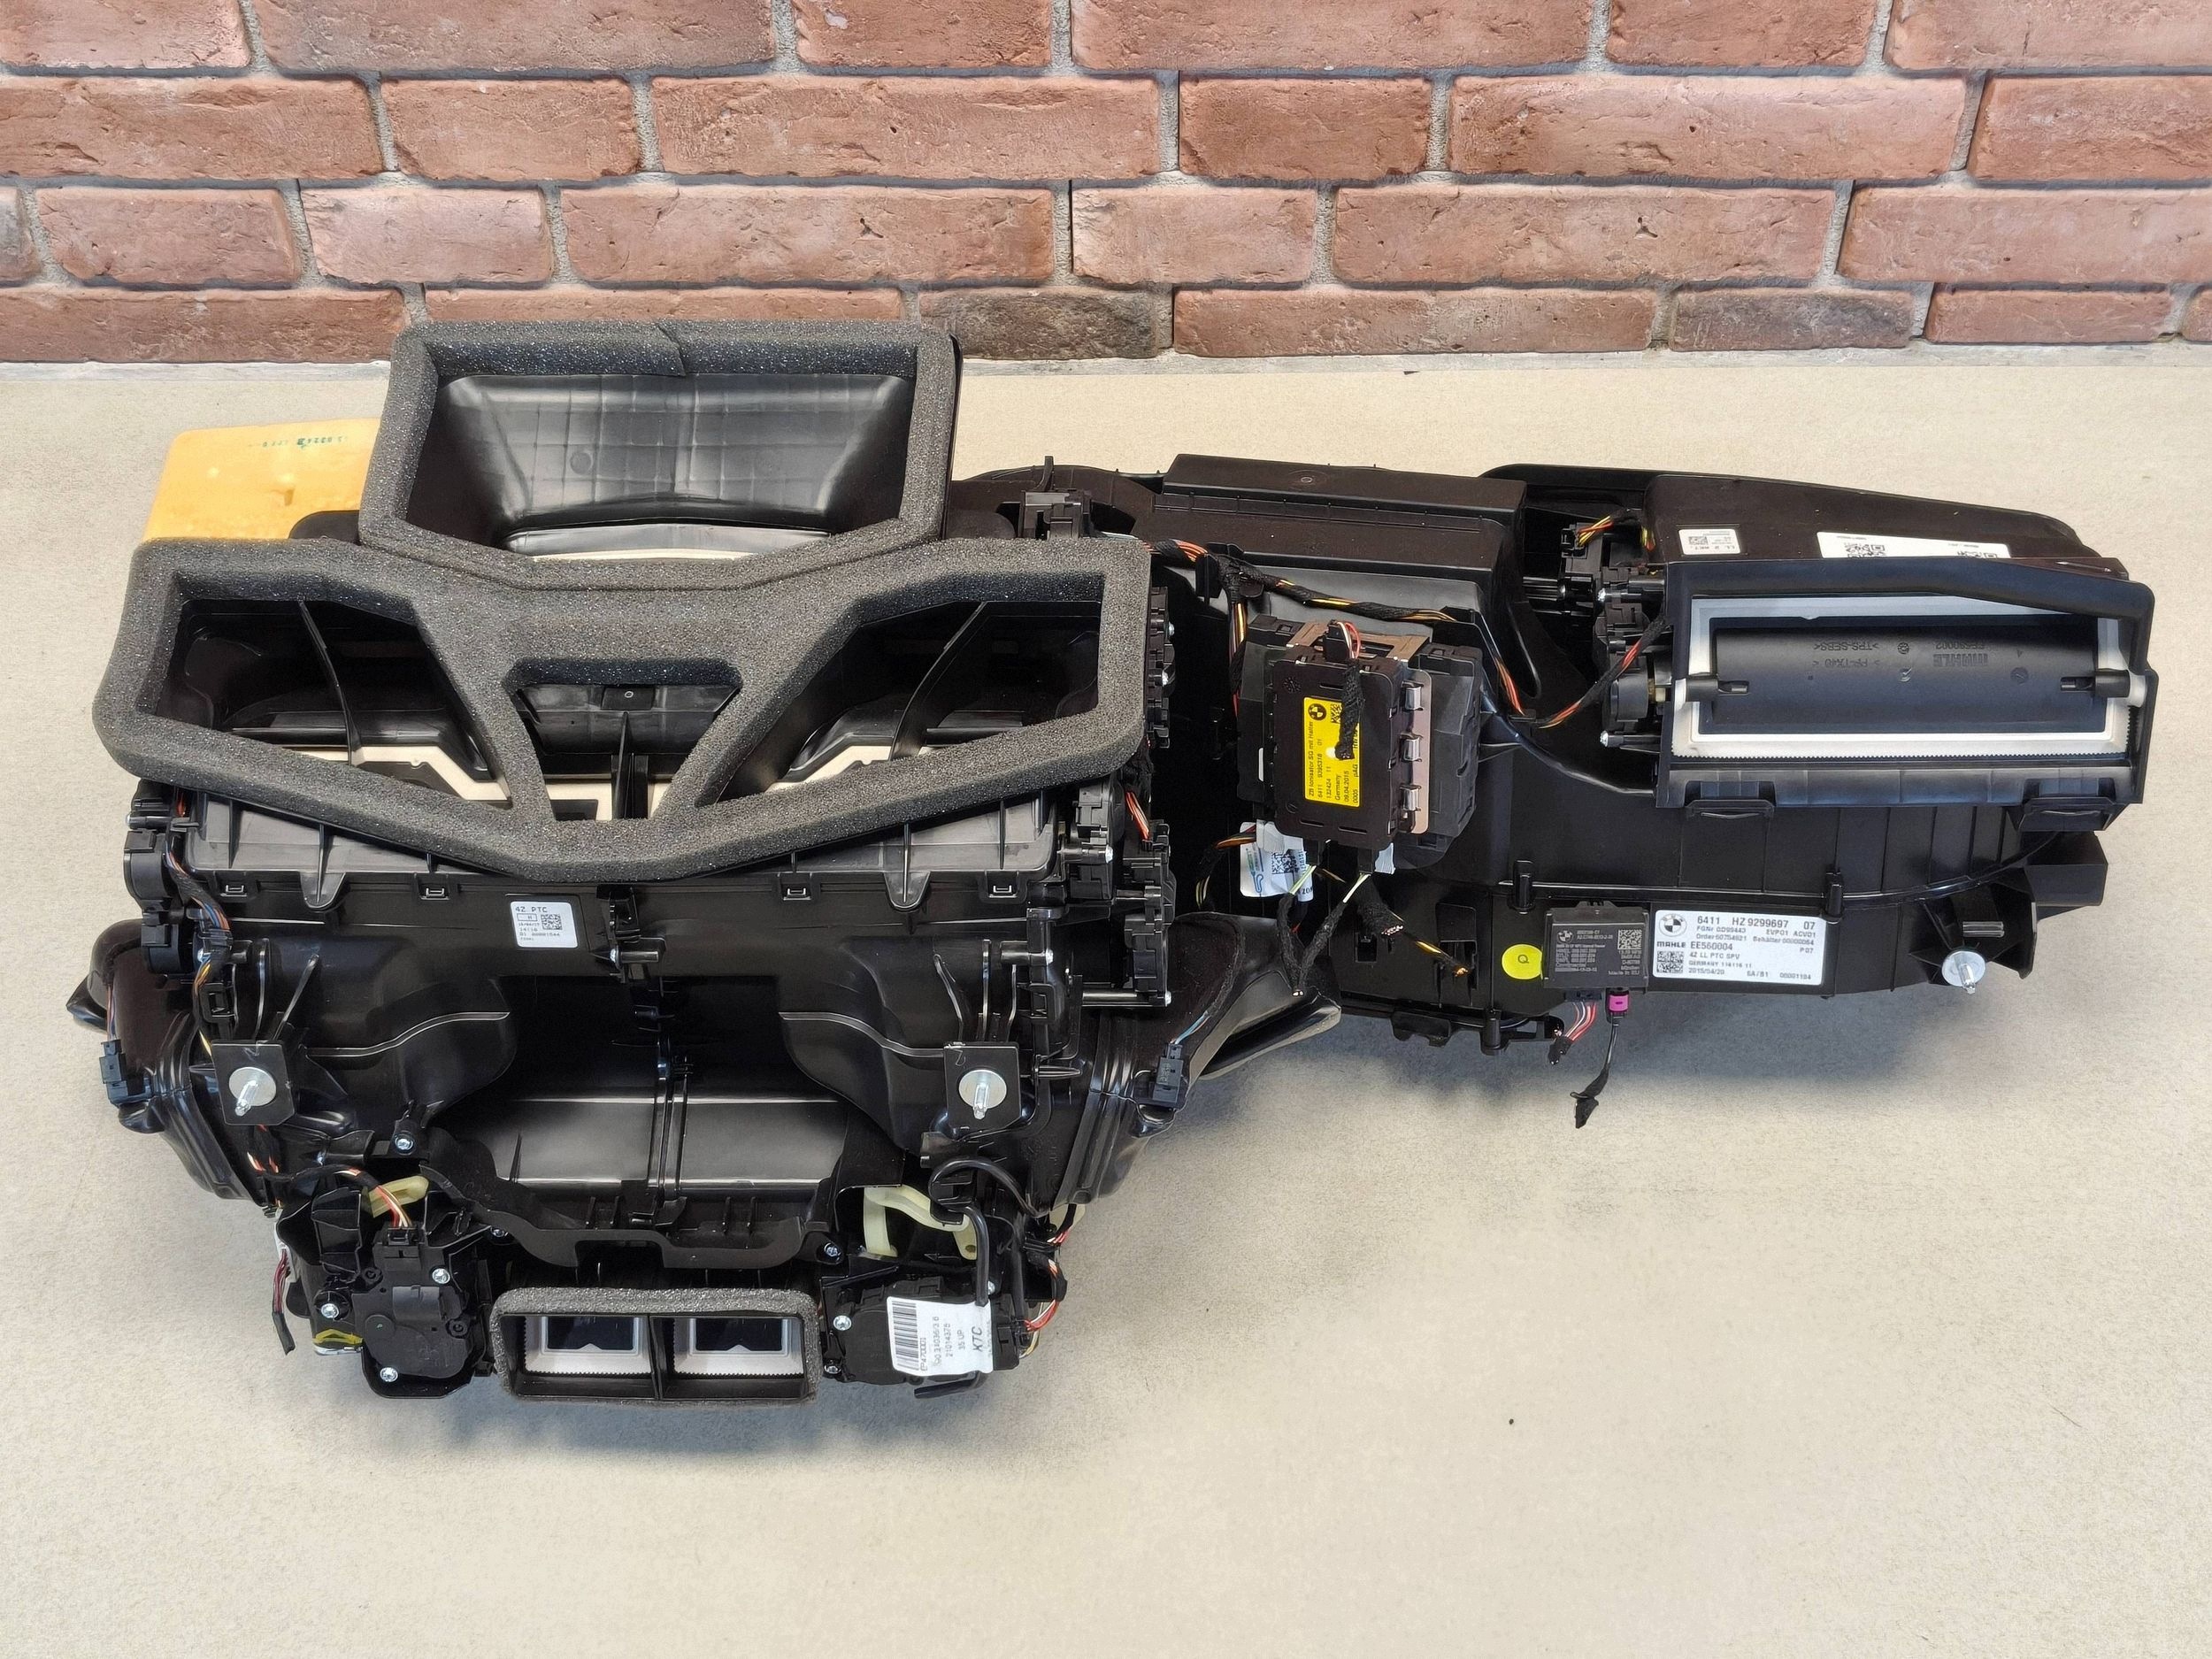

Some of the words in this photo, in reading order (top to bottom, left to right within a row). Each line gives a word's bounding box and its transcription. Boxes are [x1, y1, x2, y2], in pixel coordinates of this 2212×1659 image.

[1697, 915, 1720, 926] 6411
[1732, 917, 1746, 926] HZ
[1747, 918, 1789, 928] 9299697
[1803, 921, 1816, 930] 07
[1690, 941, 1733, 950] EE560004
[1517, 954, 1530, 964] Q
